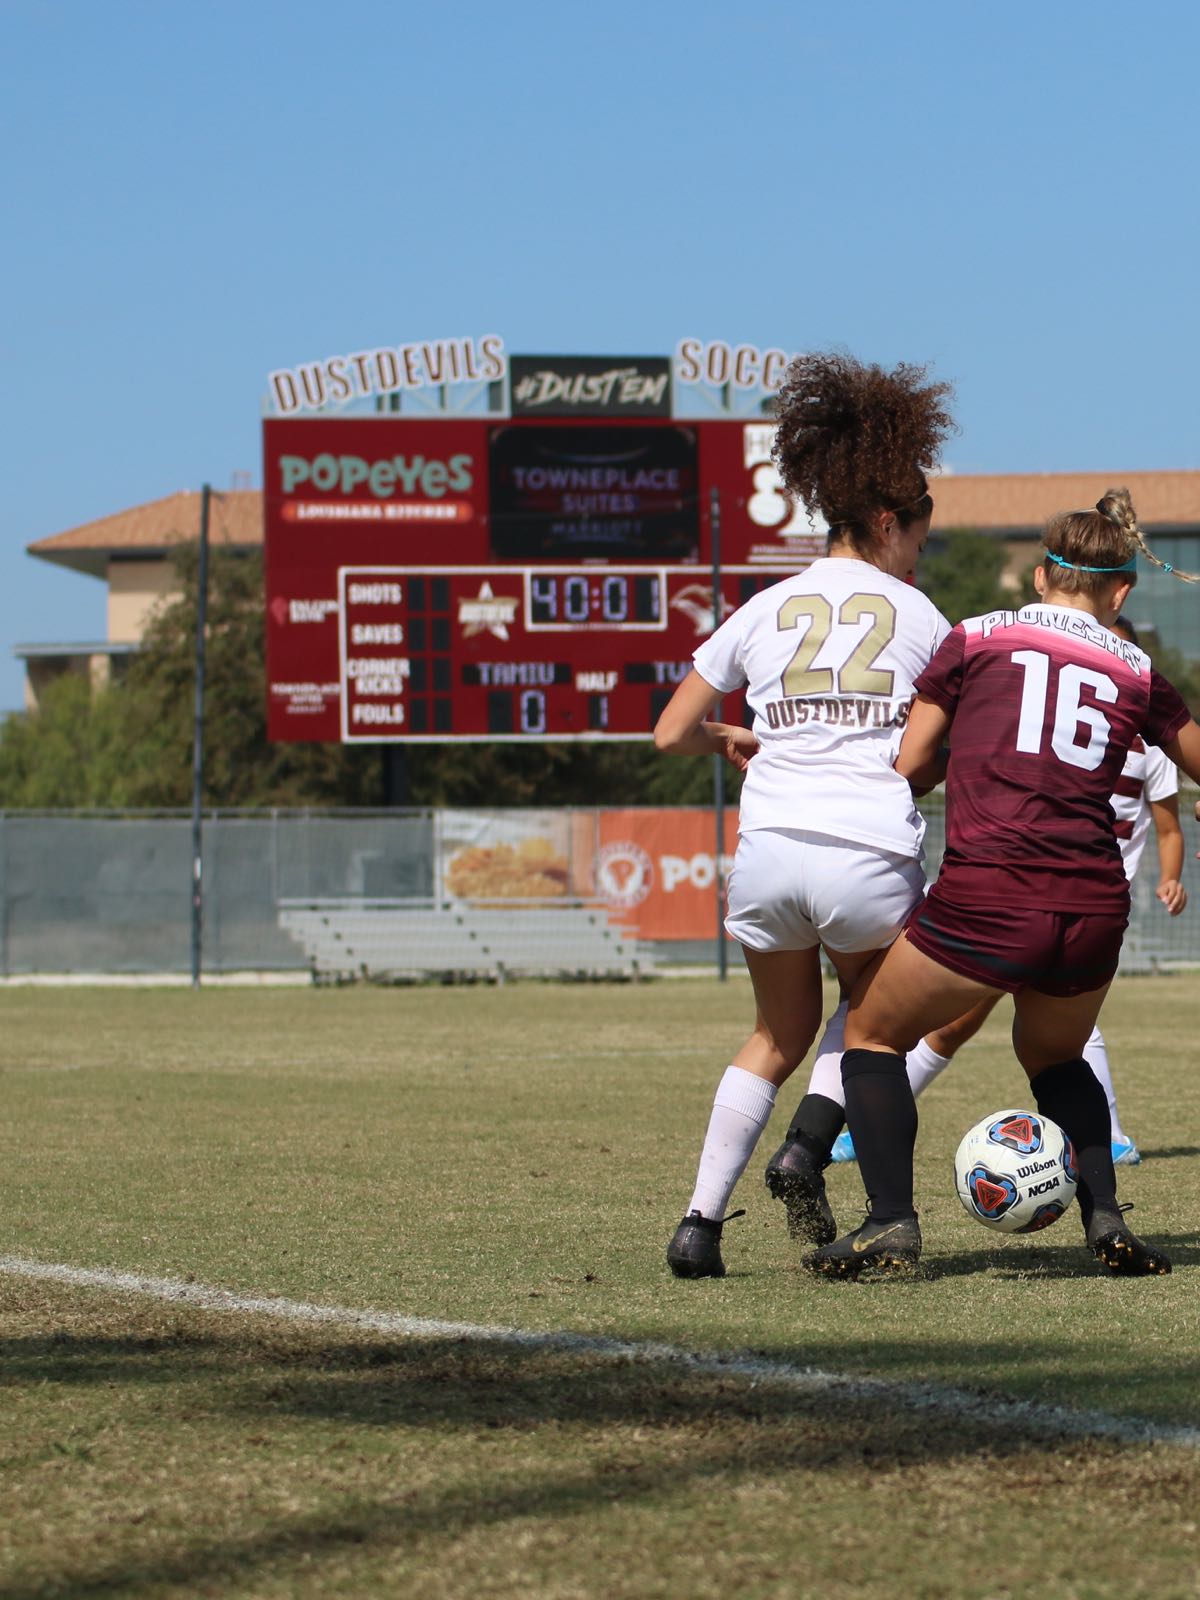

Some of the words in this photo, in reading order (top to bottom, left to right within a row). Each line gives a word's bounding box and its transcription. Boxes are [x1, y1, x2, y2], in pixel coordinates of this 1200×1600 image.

[271, 337, 504, 414] DUSTDEVILS
[678, 339, 790, 395] SOCC
[512, 468, 679, 490] TOWNEPLACE
[563, 495, 640, 514] SUITES
[349, 583, 402, 605] SHOTS
[532, 576, 660, 622] 40:01
[351, 623, 403, 644] SAVES
[776, 592, 897, 698] 22
[347, 658, 410, 679] CORNER
[477, 661, 555, 685] TAMIU
[355, 678, 403, 695] KICKS
[575, 671, 619, 692] HALF
[352, 703, 404, 724] FOULS
[520, 689, 546, 734] 0
[765, 698, 910, 730] DUSTDEVILS
[1010, 649, 1119, 772] 16
[1016, 1158, 1057, 1179] Wilson
[1028, 1176, 1061, 1198] NCAA
